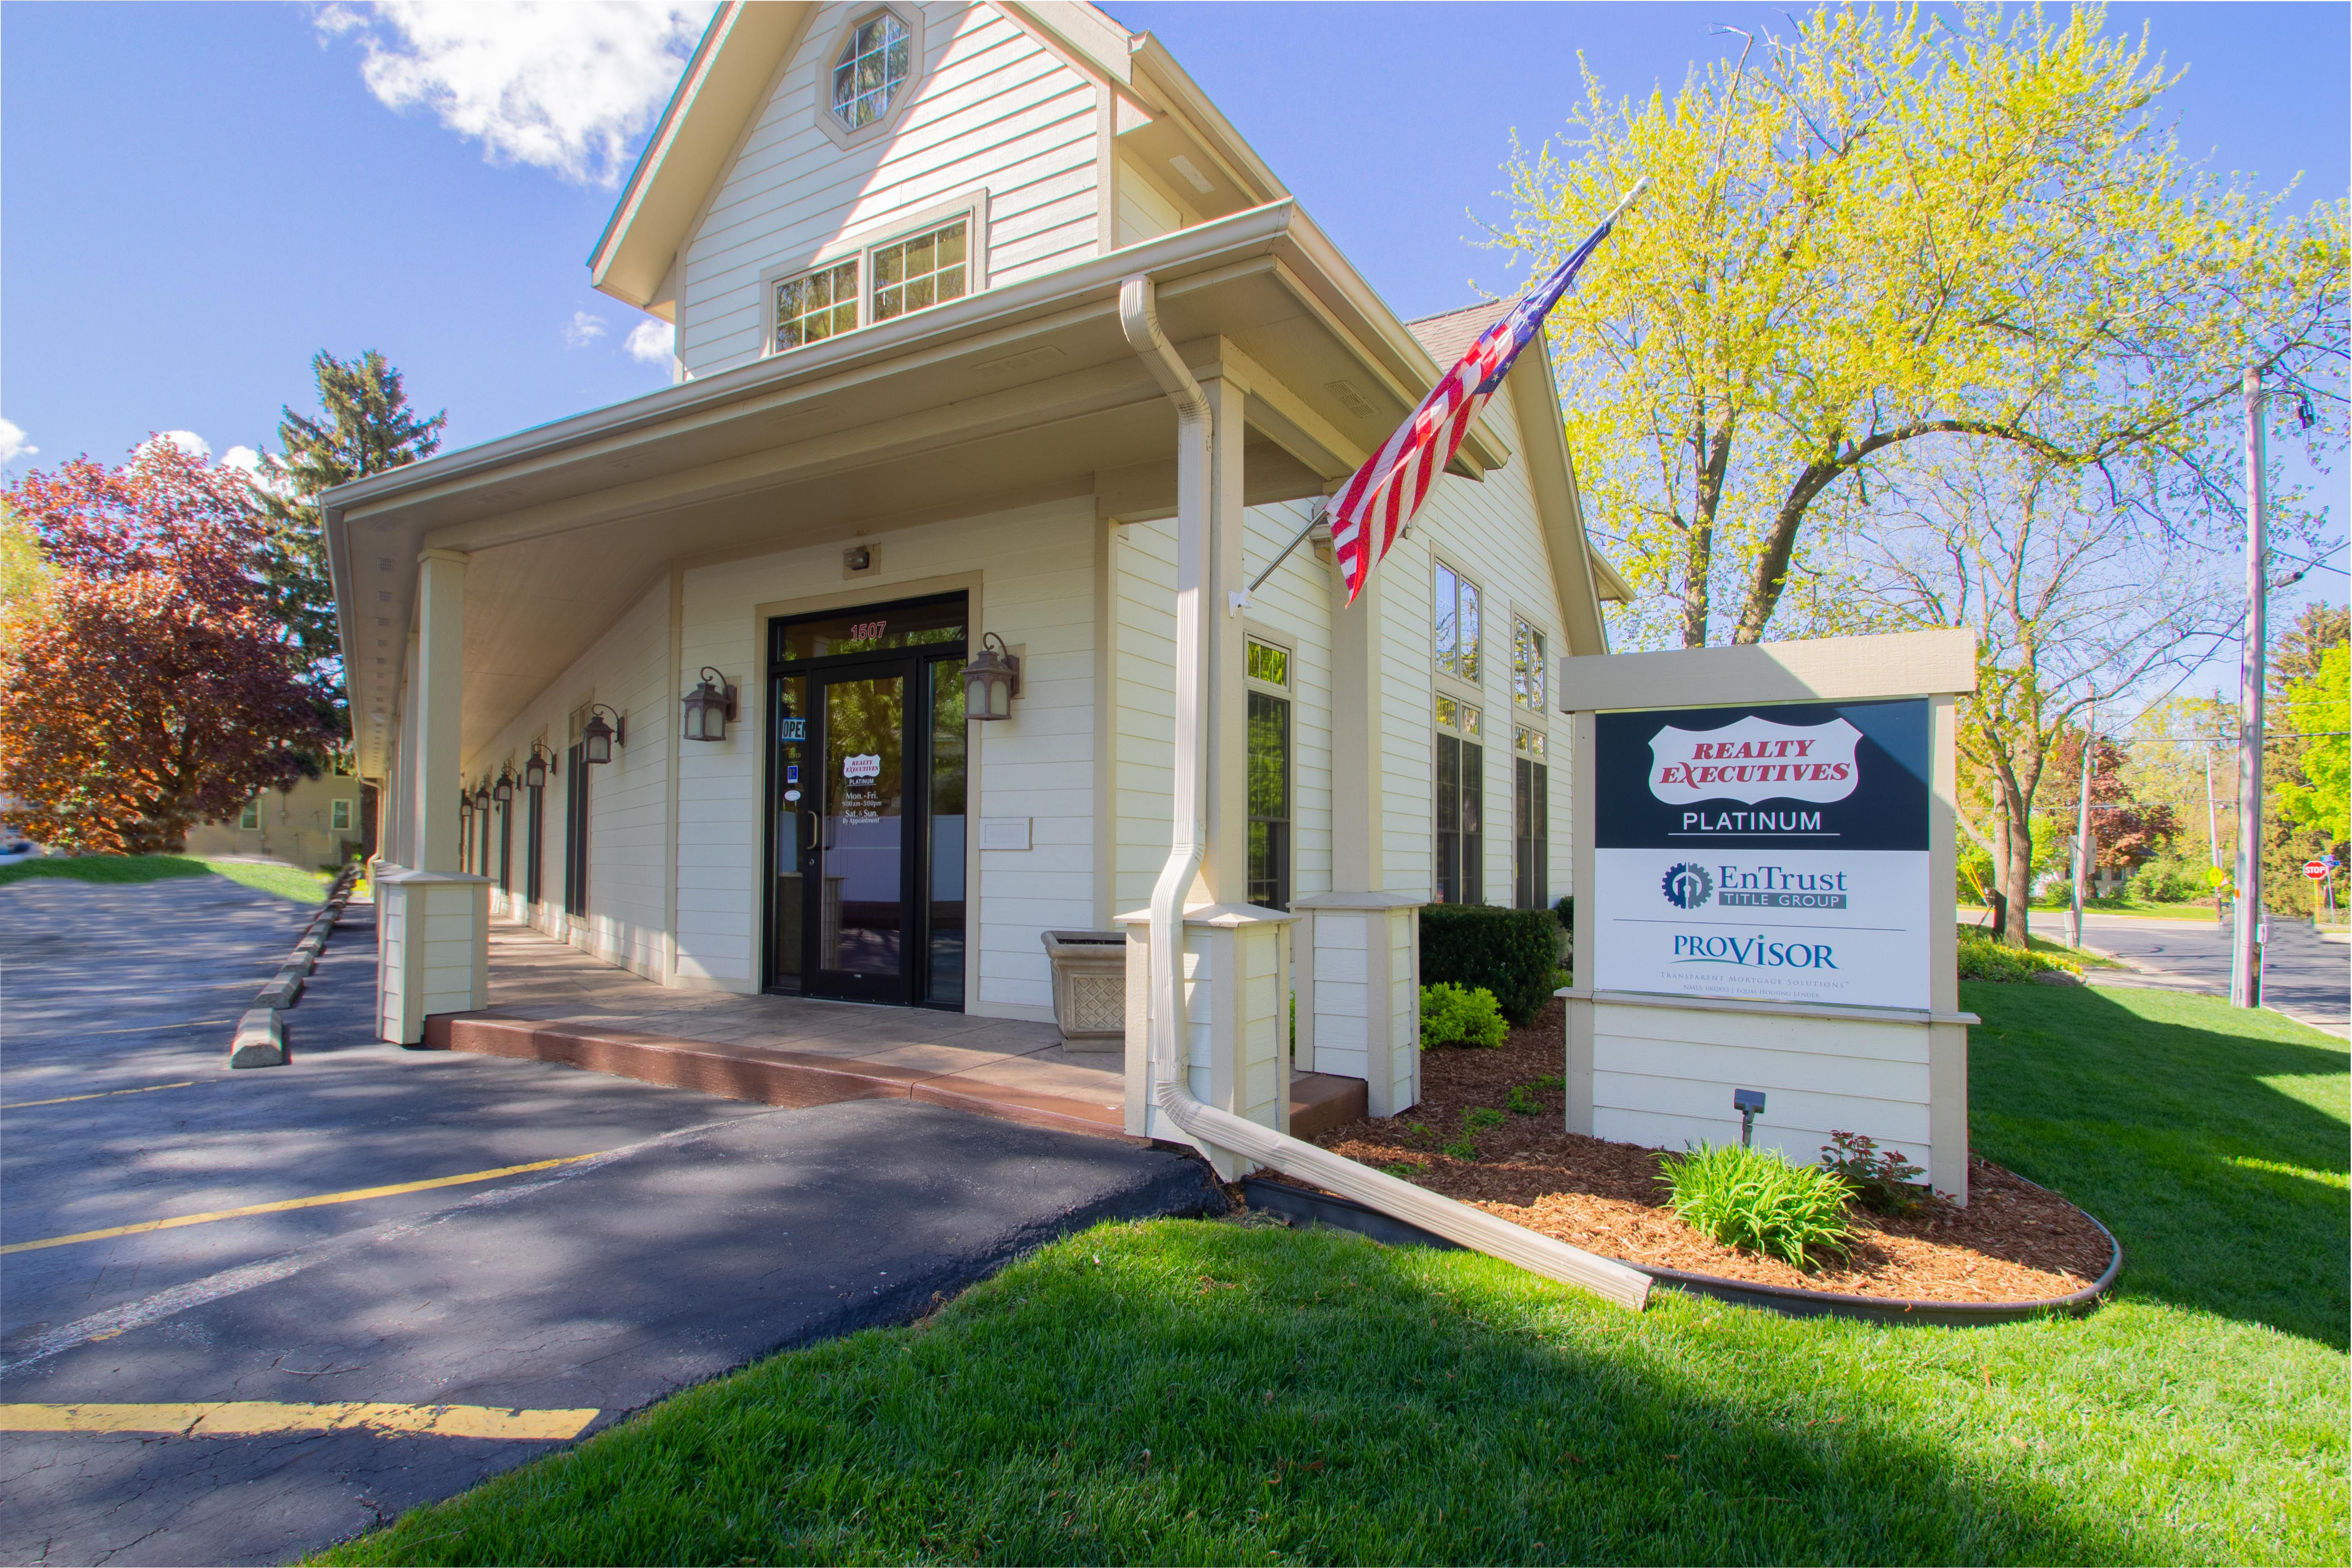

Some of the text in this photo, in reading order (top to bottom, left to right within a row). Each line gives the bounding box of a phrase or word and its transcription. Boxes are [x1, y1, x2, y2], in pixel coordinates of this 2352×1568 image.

[851, 621, 886, 641] 1507
[1691, 740, 1816, 760] REALTY
[846, 765, 879, 774] EXECUTIVES
[1659, 762, 1851, 789] EXECUTIVES
[867, 791, 878, 799] Fri.
[849, 817, 879, 825] Appointment
[864, 809, 878, 817] Sun.
[1683, 812, 1821, 830] PLATINUM
[1718, 866, 1847, 891] EnTrust
[1724, 893, 1839, 907] TITLE GROUP
